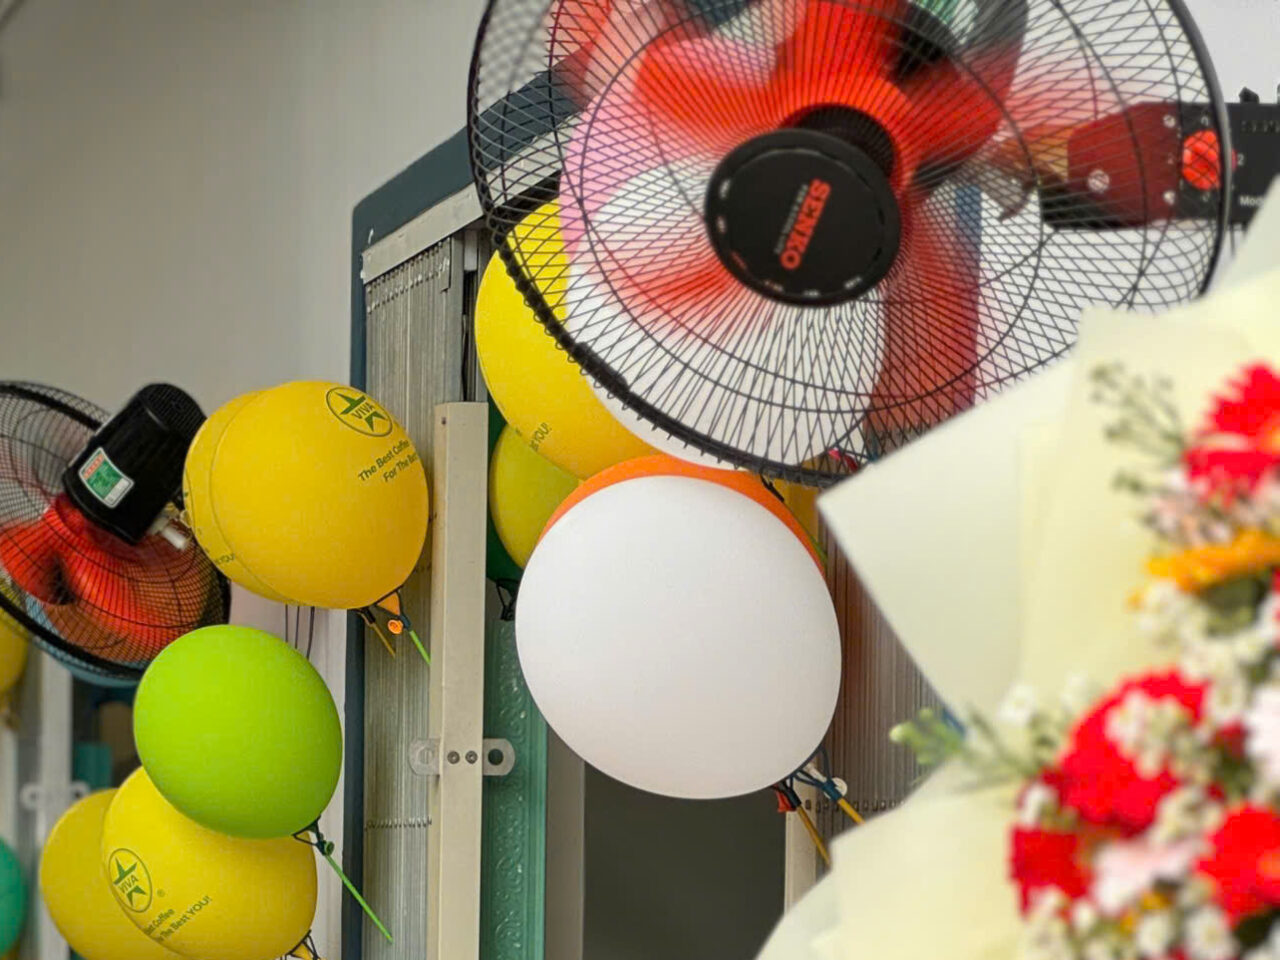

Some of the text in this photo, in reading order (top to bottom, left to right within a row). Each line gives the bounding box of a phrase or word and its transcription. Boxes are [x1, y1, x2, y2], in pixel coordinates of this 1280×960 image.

[779, 178, 832, 270] SENKO
[351, 402, 376, 420] VIVA
[358, 465, 377, 481] The
[376, 449, 395, 468] Best
[383, 467, 398, 482] For
[396, 458, 409, 471] The
[118, 874, 139, 894] VIVA
[152, 908, 175, 926] Coffee
[170, 914, 190, 930] Best
[187, 895, 212, 916] YOU!
